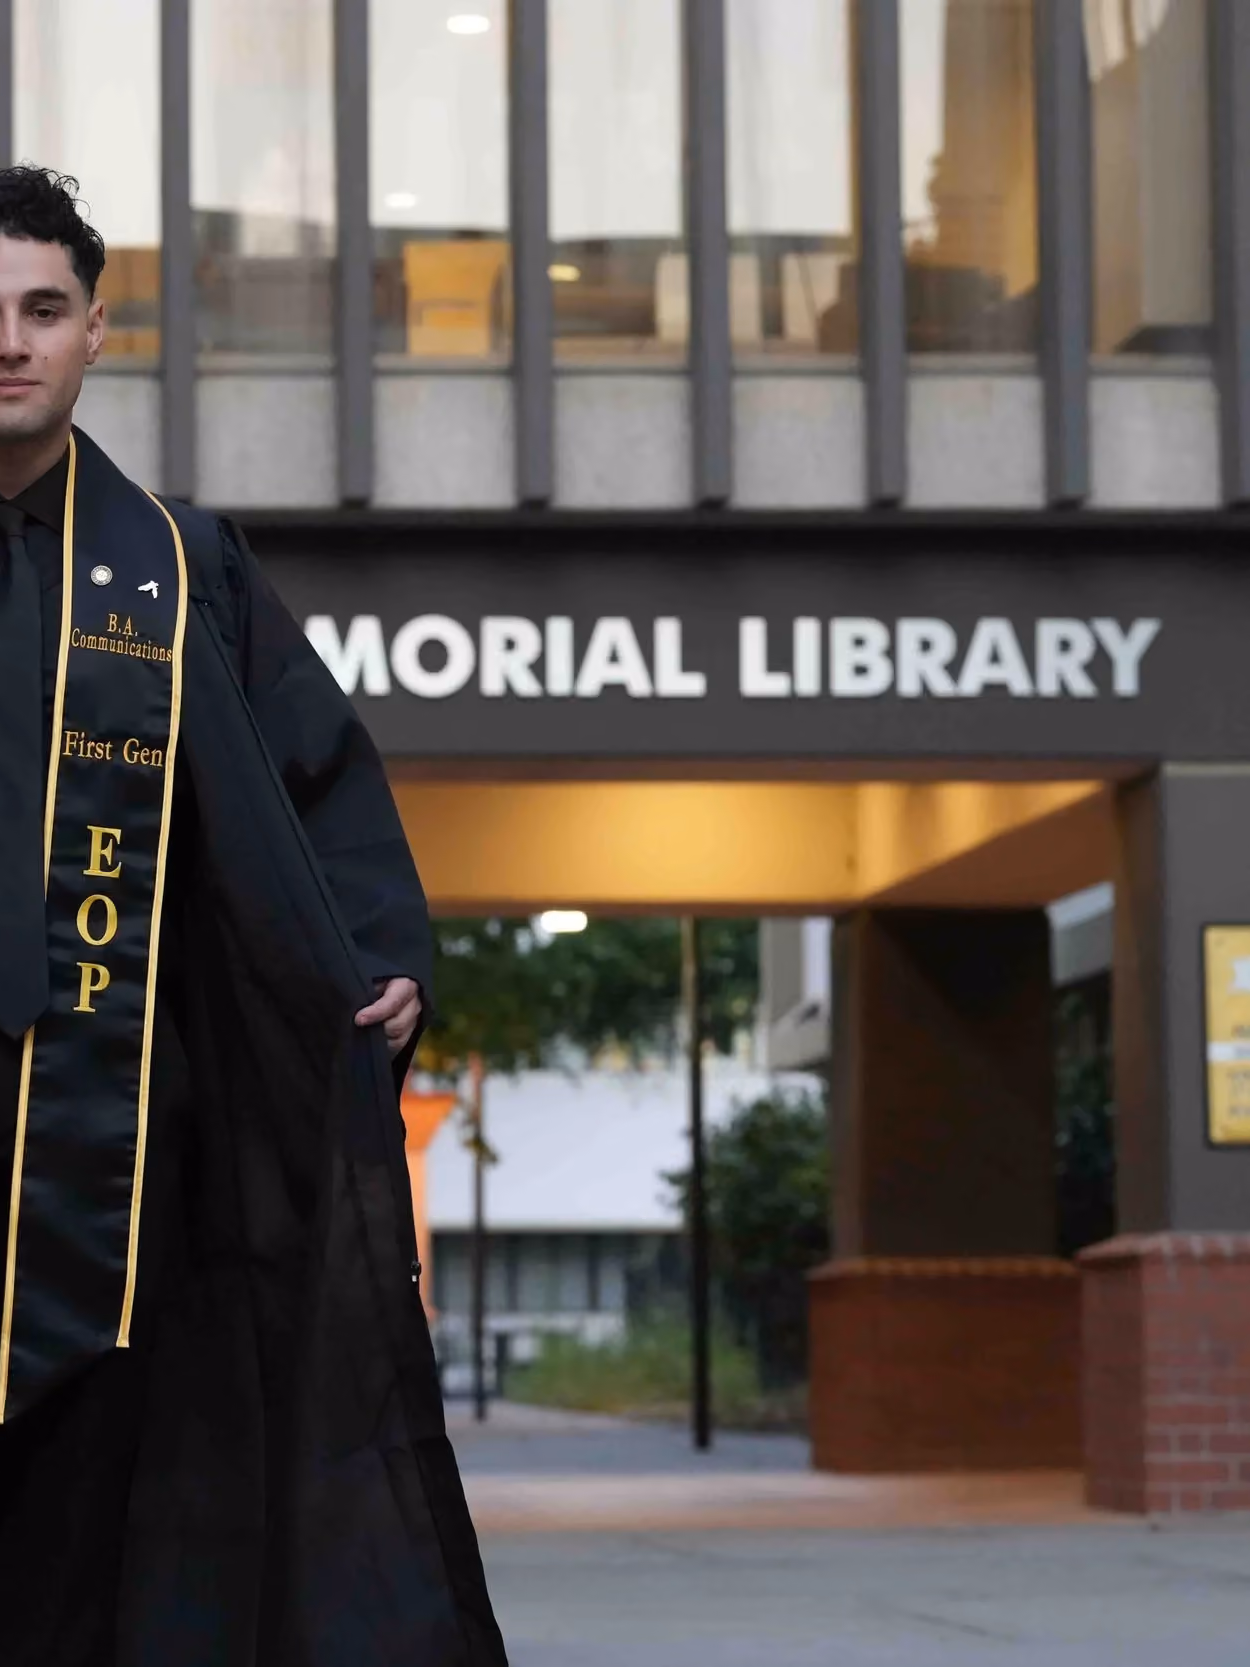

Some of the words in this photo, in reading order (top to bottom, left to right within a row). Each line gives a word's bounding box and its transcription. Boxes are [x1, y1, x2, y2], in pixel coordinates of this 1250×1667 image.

[107, 613, 138, 637] B.A.
[71, 628, 172, 662] Communications
[303, 613, 707, 698] MORIAL
[738, 615, 1160, 698] LIBRARY
[62, 730, 113, 762] First
[122, 738, 163, 768] Gen
